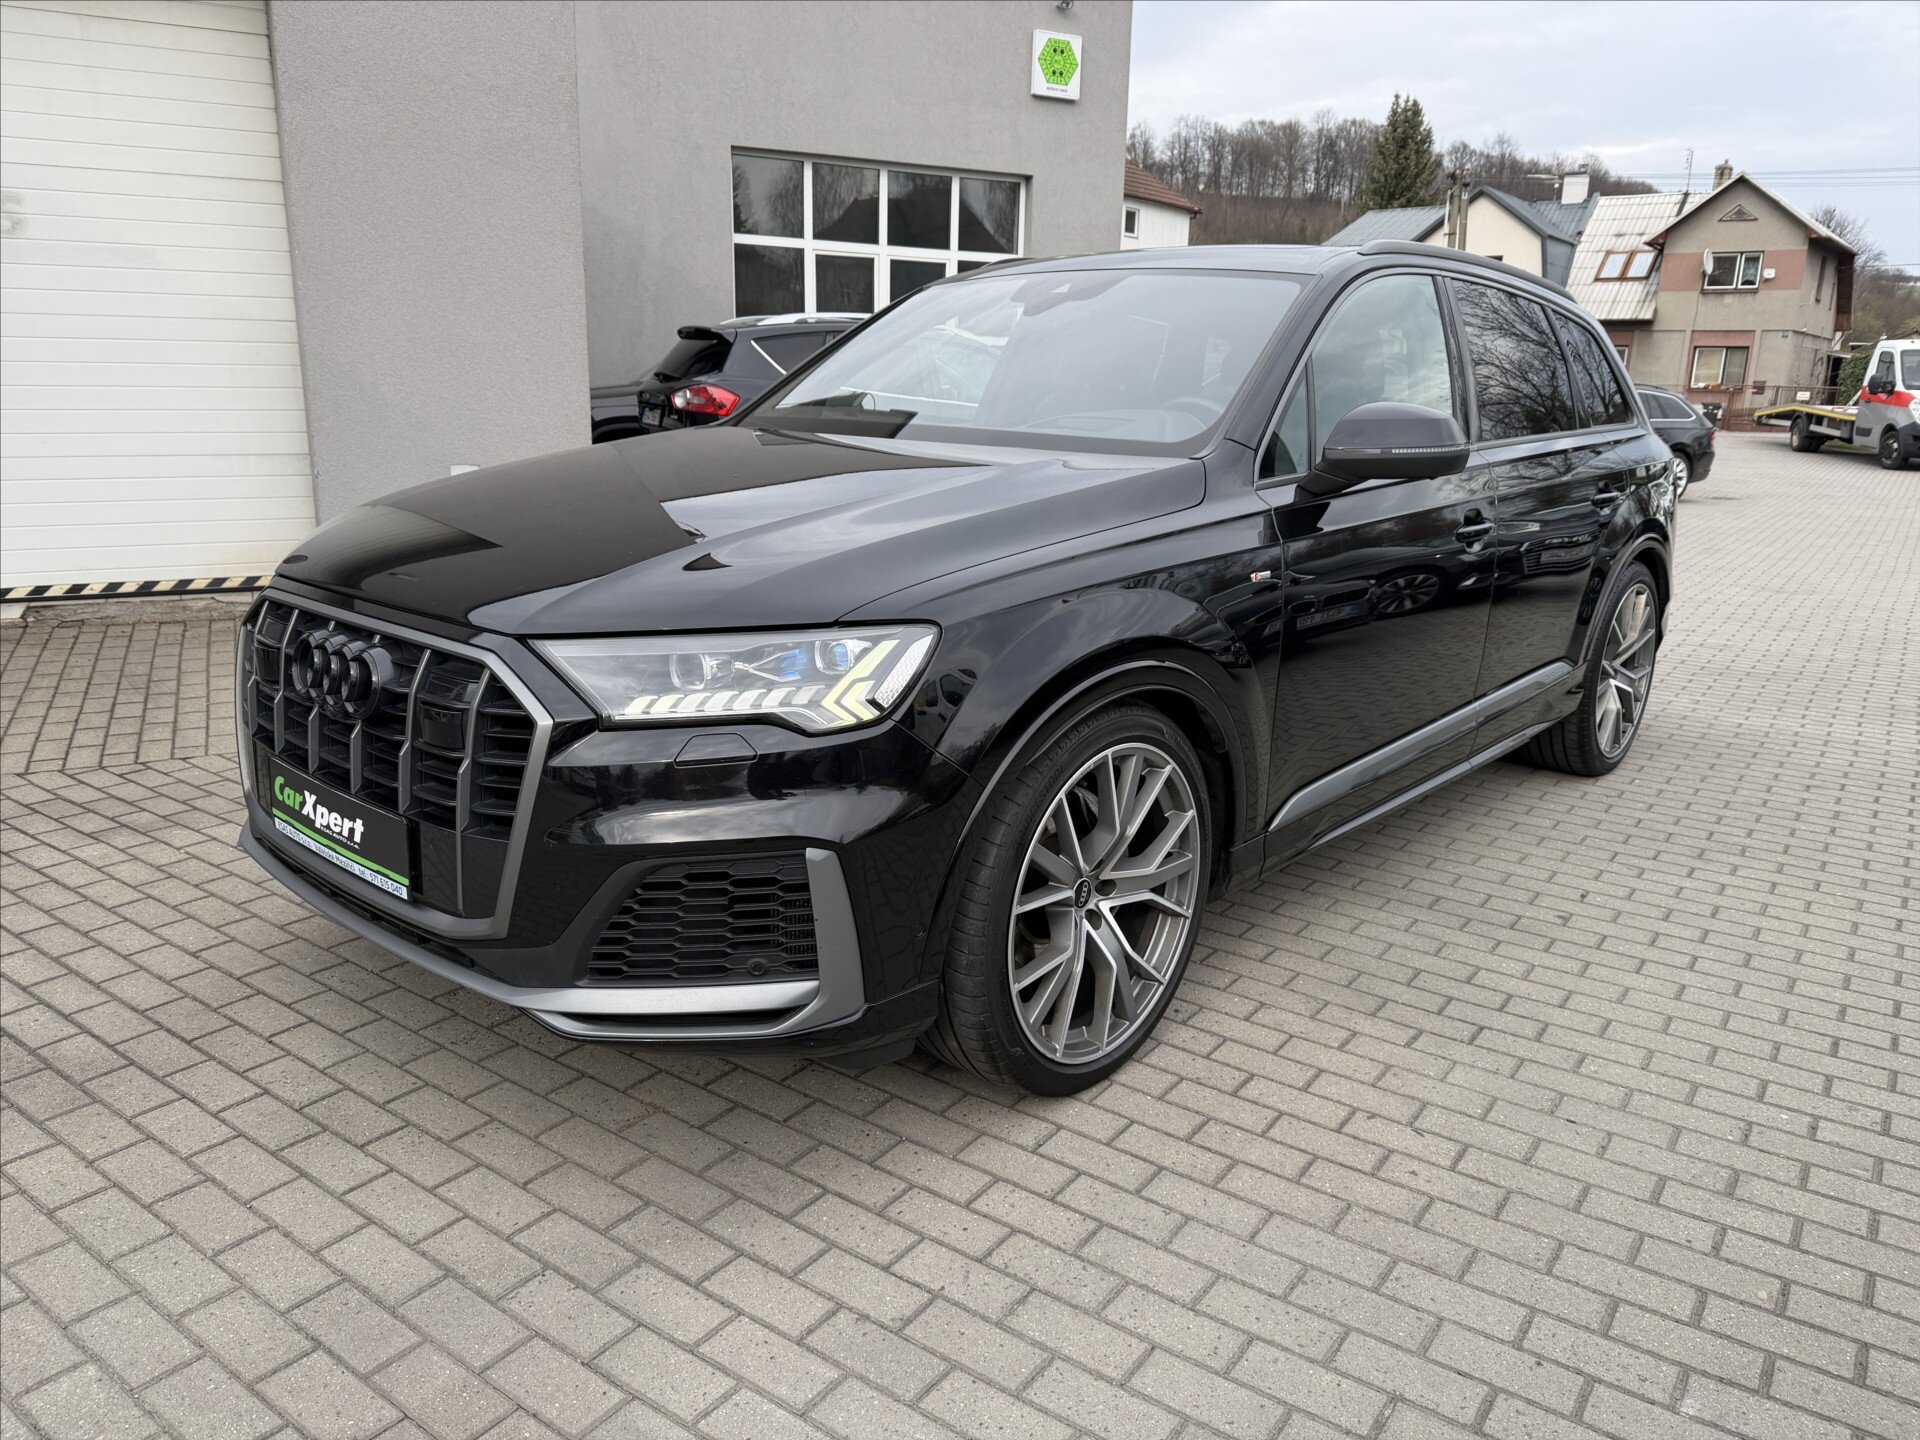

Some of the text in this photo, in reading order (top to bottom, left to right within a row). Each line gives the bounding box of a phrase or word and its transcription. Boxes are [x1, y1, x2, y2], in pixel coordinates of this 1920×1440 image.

[274, 775, 364, 843] CarXpert
[333, 833, 347, 843] AUTO
[369, 872, 380, 884] 571
[379, 878, 390, 890] 615
[390, 883, 403, 896] 040
